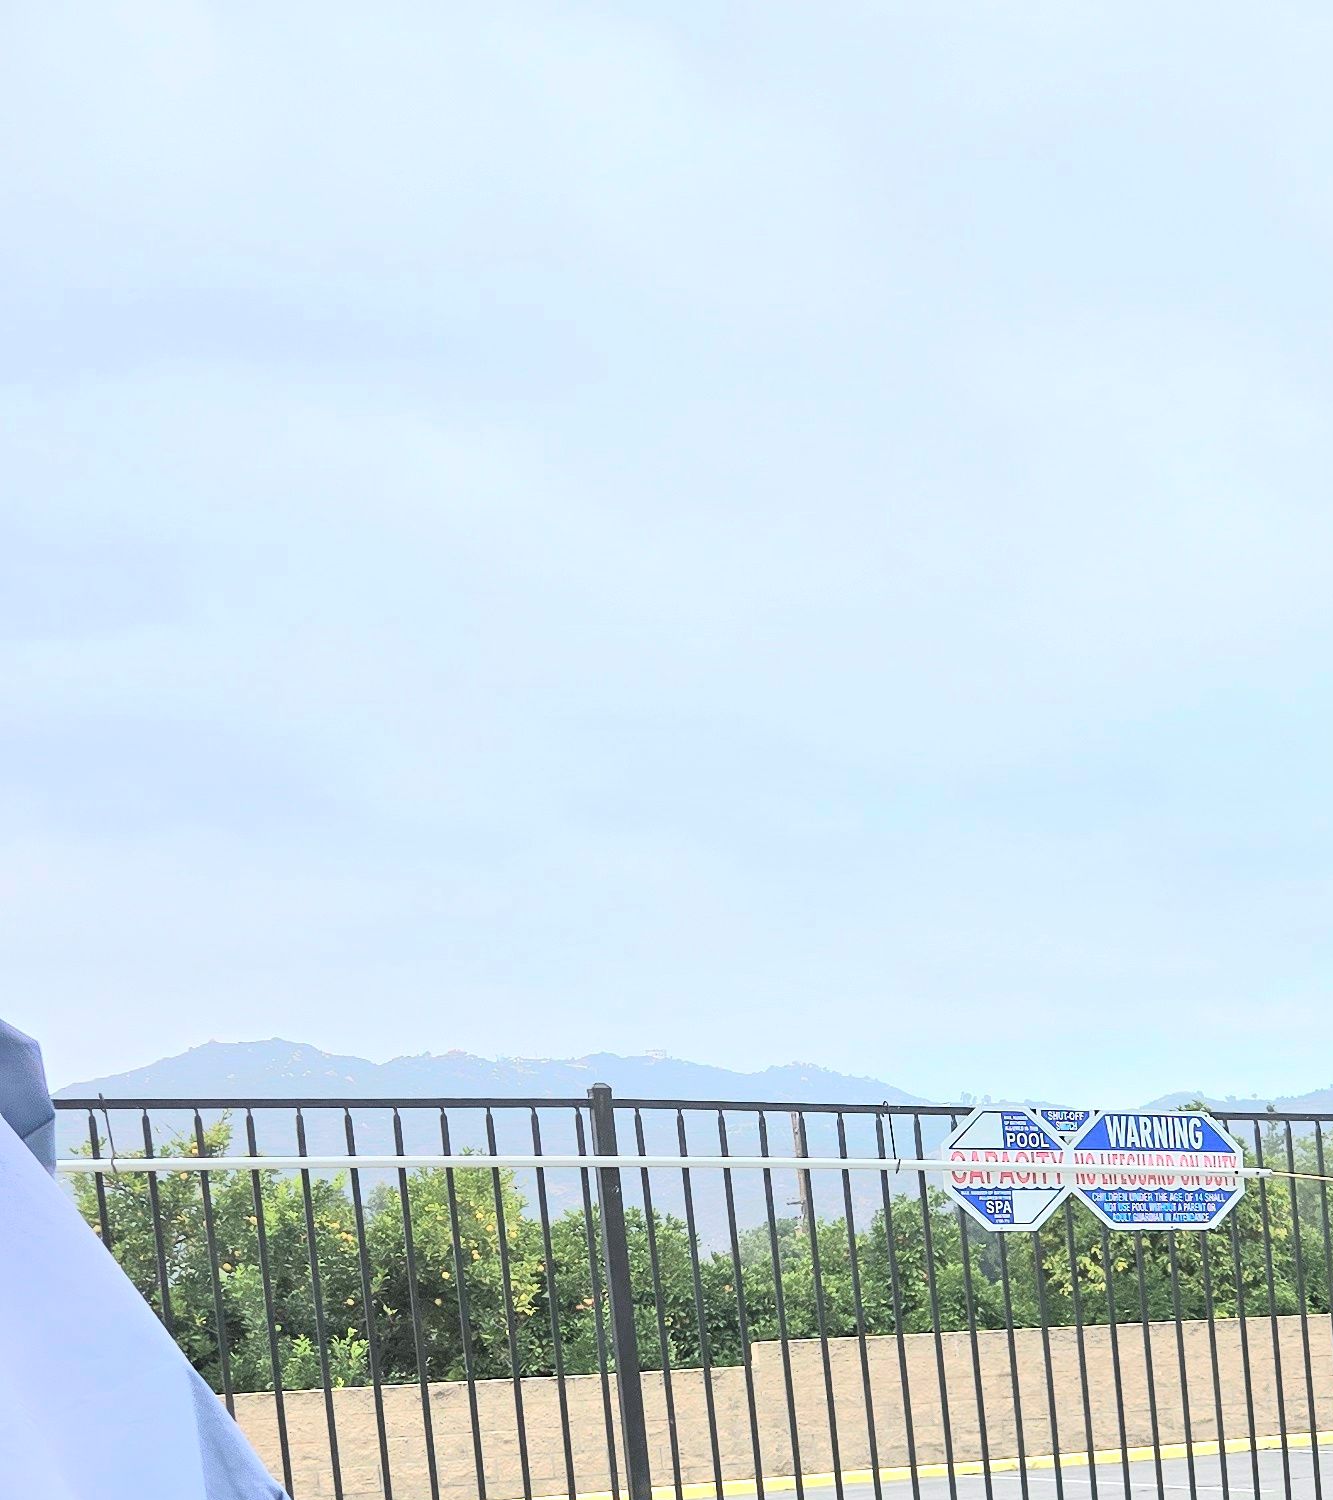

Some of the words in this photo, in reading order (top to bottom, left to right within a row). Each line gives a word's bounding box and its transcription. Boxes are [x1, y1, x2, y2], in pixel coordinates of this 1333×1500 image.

[1006, 1132, 1050, 1148] POOL
[1104, 1116, 1204, 1150] WARNING
[950, 1150, 1064, 1184] CAPACITY
[1074, 1152, 1096, 1184] NO
[1100, 1153, 1175, 1185] LIFEGUARD
[1180, 1154, 1200, 1186] ON
[1204, 1155, 1237, 1186] DUTY
[1154, 1192, 1168, 1202] THE
[1170, 1192, 1182, 1202] AGE
[1194, 1192, 1203, 1202] 14
[986, 1200, 1012, 1214] SPA
[1132, 1202, 1148, 1212] POOL
